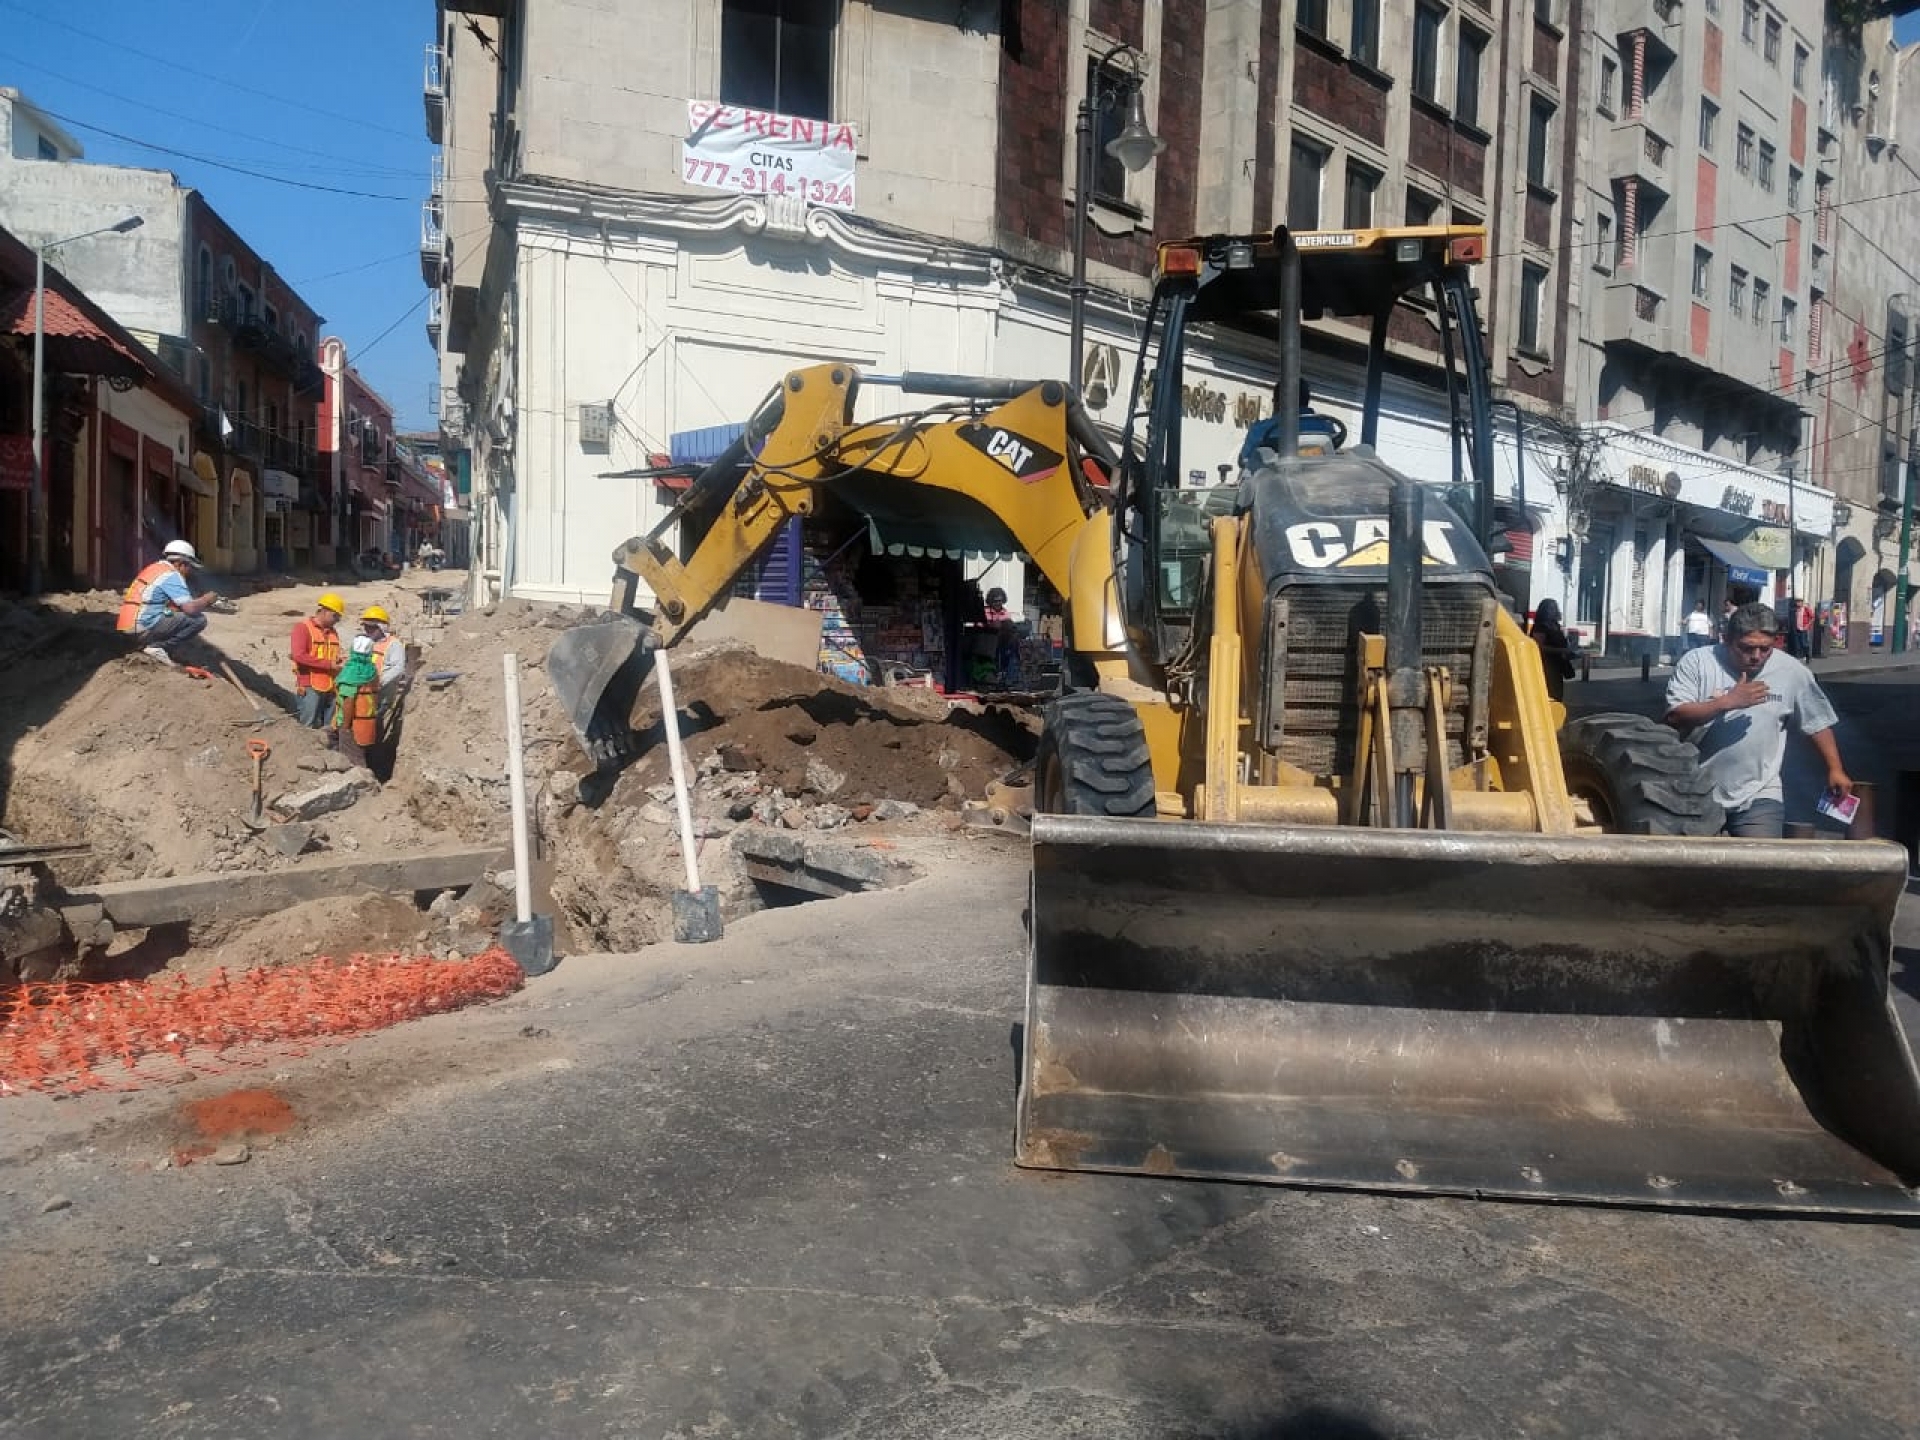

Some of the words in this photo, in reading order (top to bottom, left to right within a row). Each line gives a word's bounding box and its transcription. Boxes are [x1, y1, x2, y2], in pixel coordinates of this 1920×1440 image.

[742, 108, 854, 151] RENTA
[685, 157, 853, 206] 777-314-1324
[750, 152, 793, 172] CITAS
[1295, 234, 1355, 247] CATERPILLAR
[987, 429, 1034, 473] CAT
[1285, 518, 1457, 568] CAT
